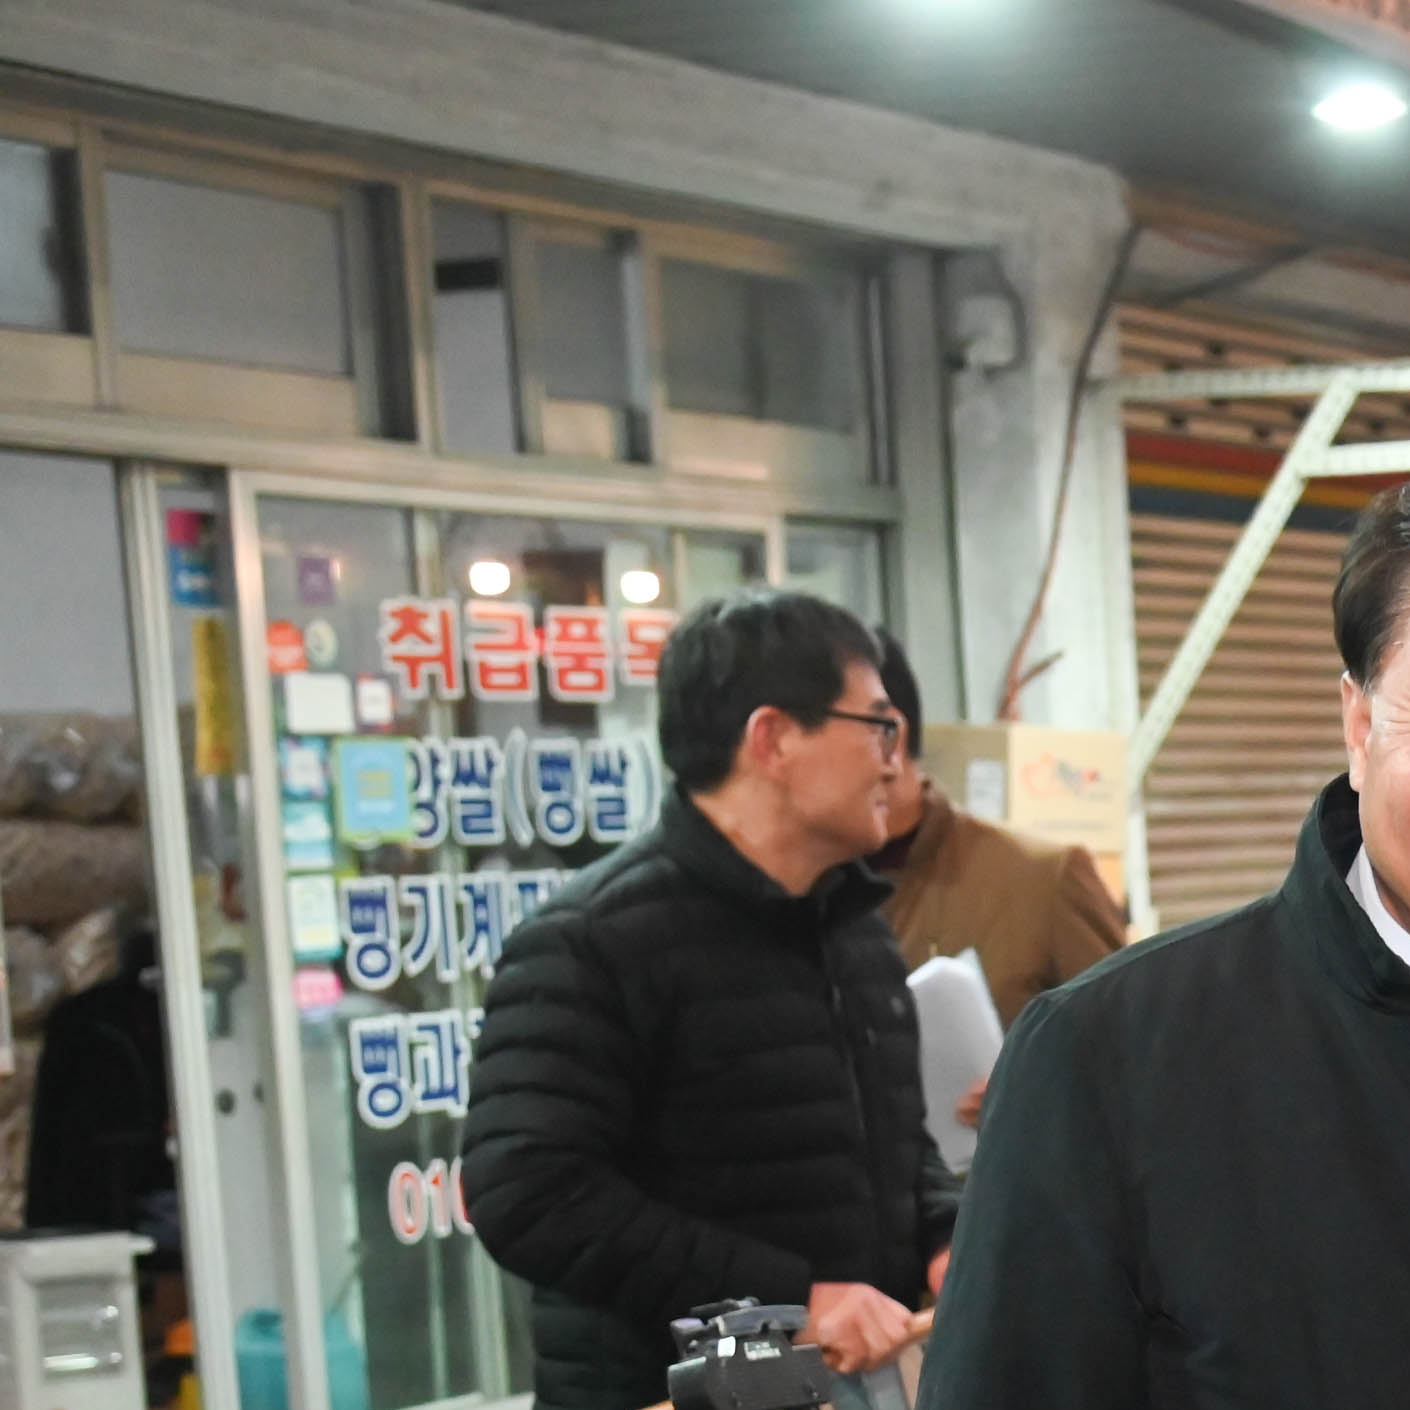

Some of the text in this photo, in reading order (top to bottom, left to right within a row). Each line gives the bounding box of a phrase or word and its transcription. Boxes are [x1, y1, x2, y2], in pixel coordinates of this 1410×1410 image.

[400, 732, 664, 848] 양쌀(뻥쌀)
[341, 870, 572, 990] 뻥기계
[352, 1009, 485, 1128] 뻥과
